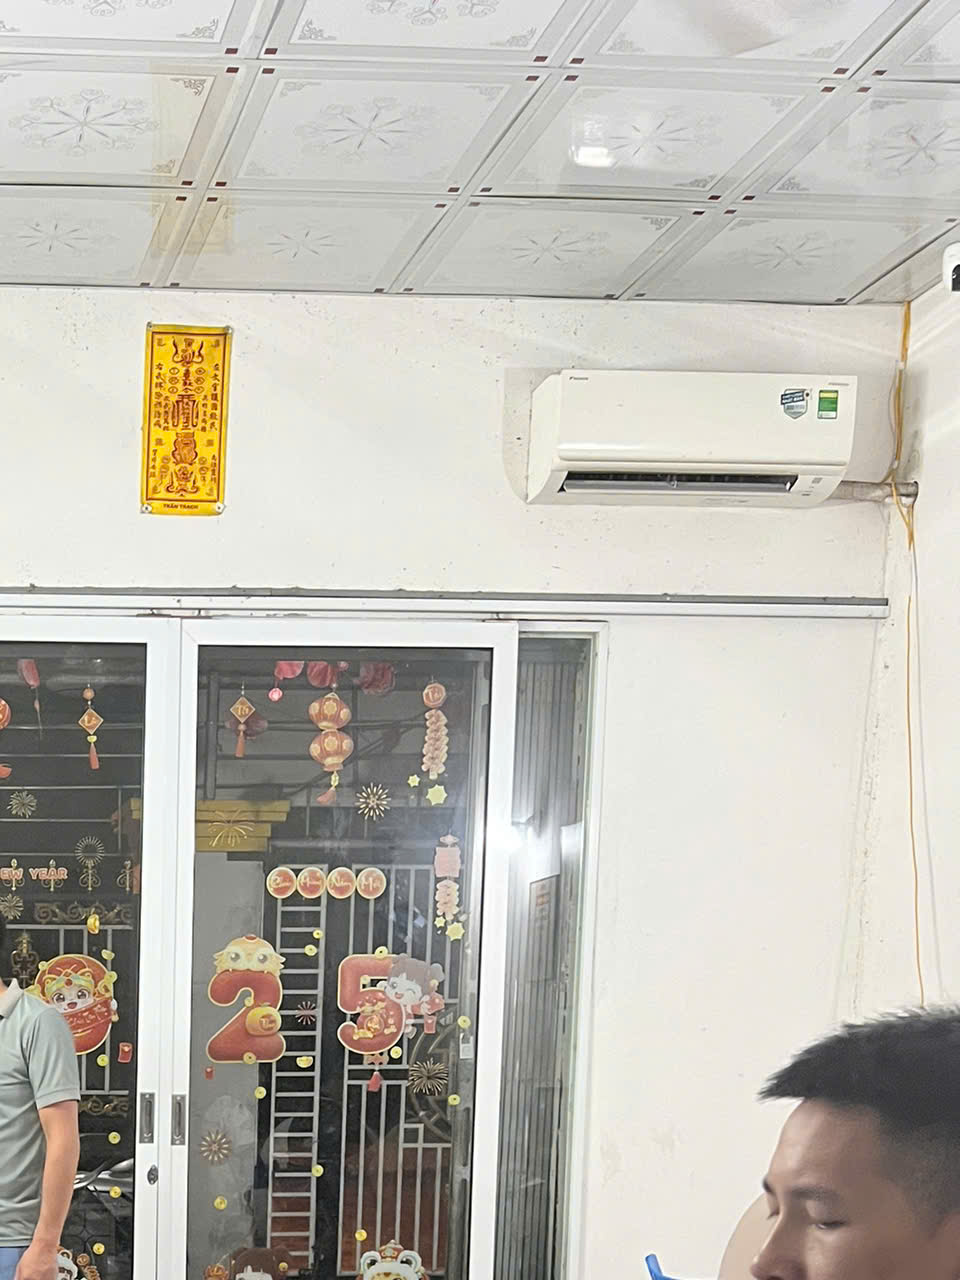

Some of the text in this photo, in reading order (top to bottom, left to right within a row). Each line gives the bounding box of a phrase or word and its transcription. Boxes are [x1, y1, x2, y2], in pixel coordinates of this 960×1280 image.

[28, 867, 68, 880] YEAR
[206, 953, 406, 1064] 2 5
